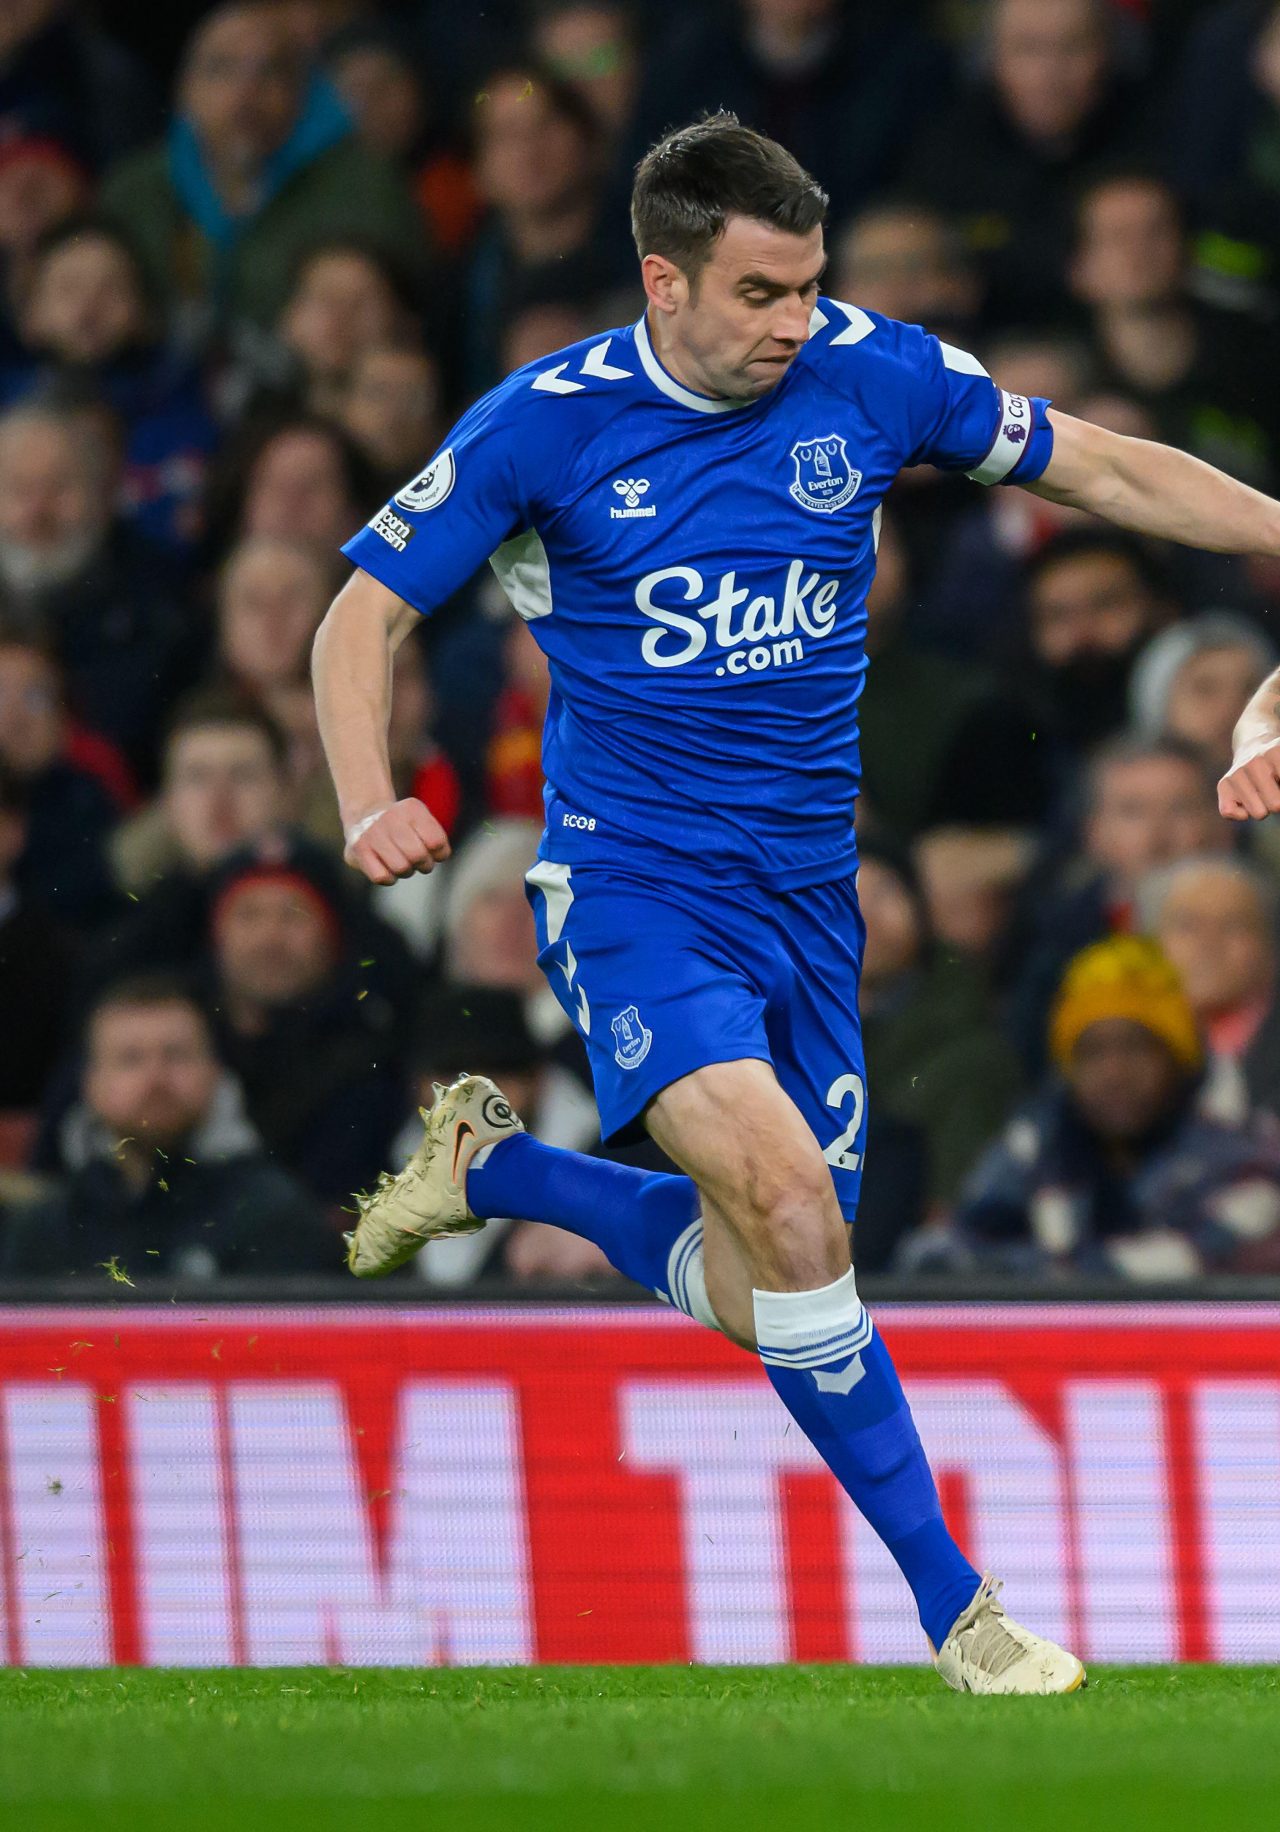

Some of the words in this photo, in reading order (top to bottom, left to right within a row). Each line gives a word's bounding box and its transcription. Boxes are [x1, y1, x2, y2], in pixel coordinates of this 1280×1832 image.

[808, 477, 843, 491] Everton
[610, 505, 656, 518] hummel
[634, 559, 840, 668] Stake
[715, 638, 804, 677] .com
[822, 1073, 868, 1172] 2
